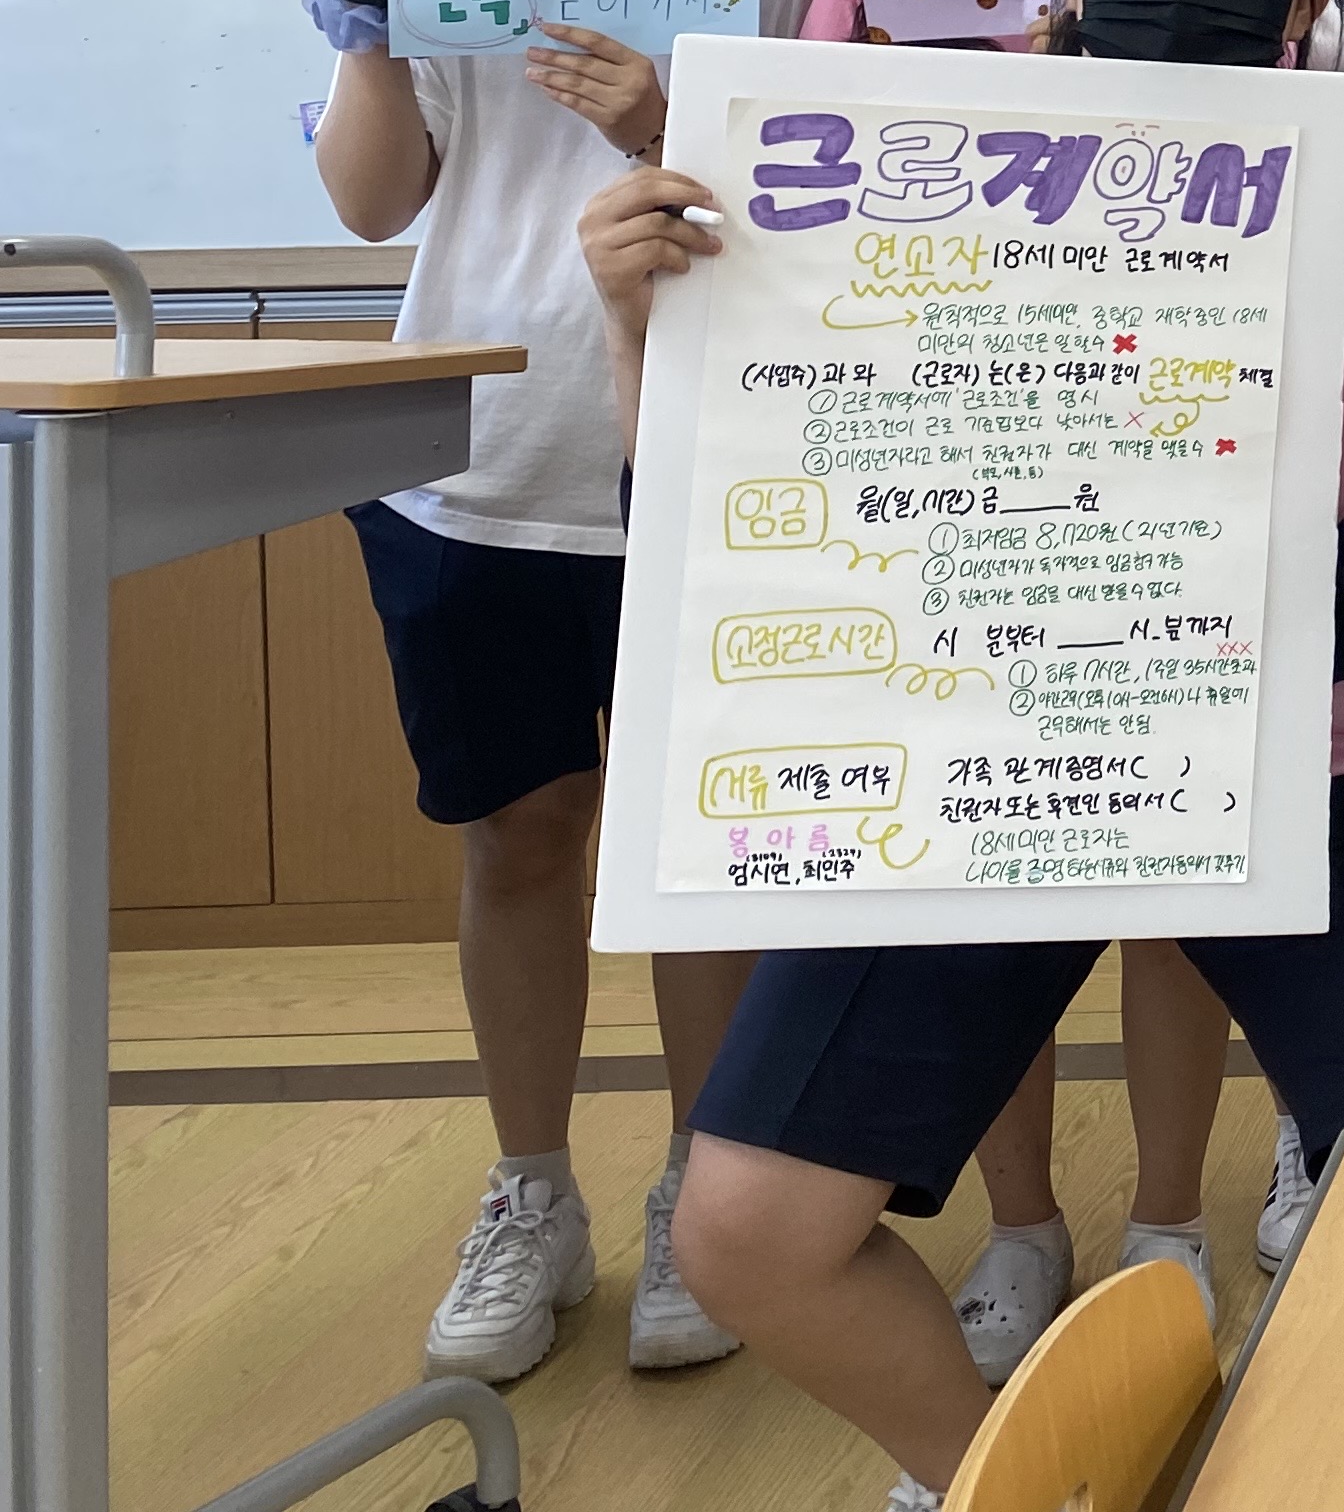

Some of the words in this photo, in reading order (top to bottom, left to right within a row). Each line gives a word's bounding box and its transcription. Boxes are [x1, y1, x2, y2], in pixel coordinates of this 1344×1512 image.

[748, 113, 1292, 243] 근로계약서
[854, 233, 988, 279] 연소자
[991, 239, 1054, 272] 18세
[1063, 244, 1107, 273] 미만
[1125, 246, 1229, 274] 근로계약서
[1054, 361, 1106, 385] 다음과
[1111, 364, 1140, 383] 같이
[1150, 357, 1236, 390] 근로계약
[926, 417, 954, 435] 근로
[734, 491, 810, 539] 임금
[778, 764, 831, 800] 제출
[842, 764, 891, 795] 여부
[948, 757, 992, 786] 가족
[1004, 793, 1041, 819] 또는
